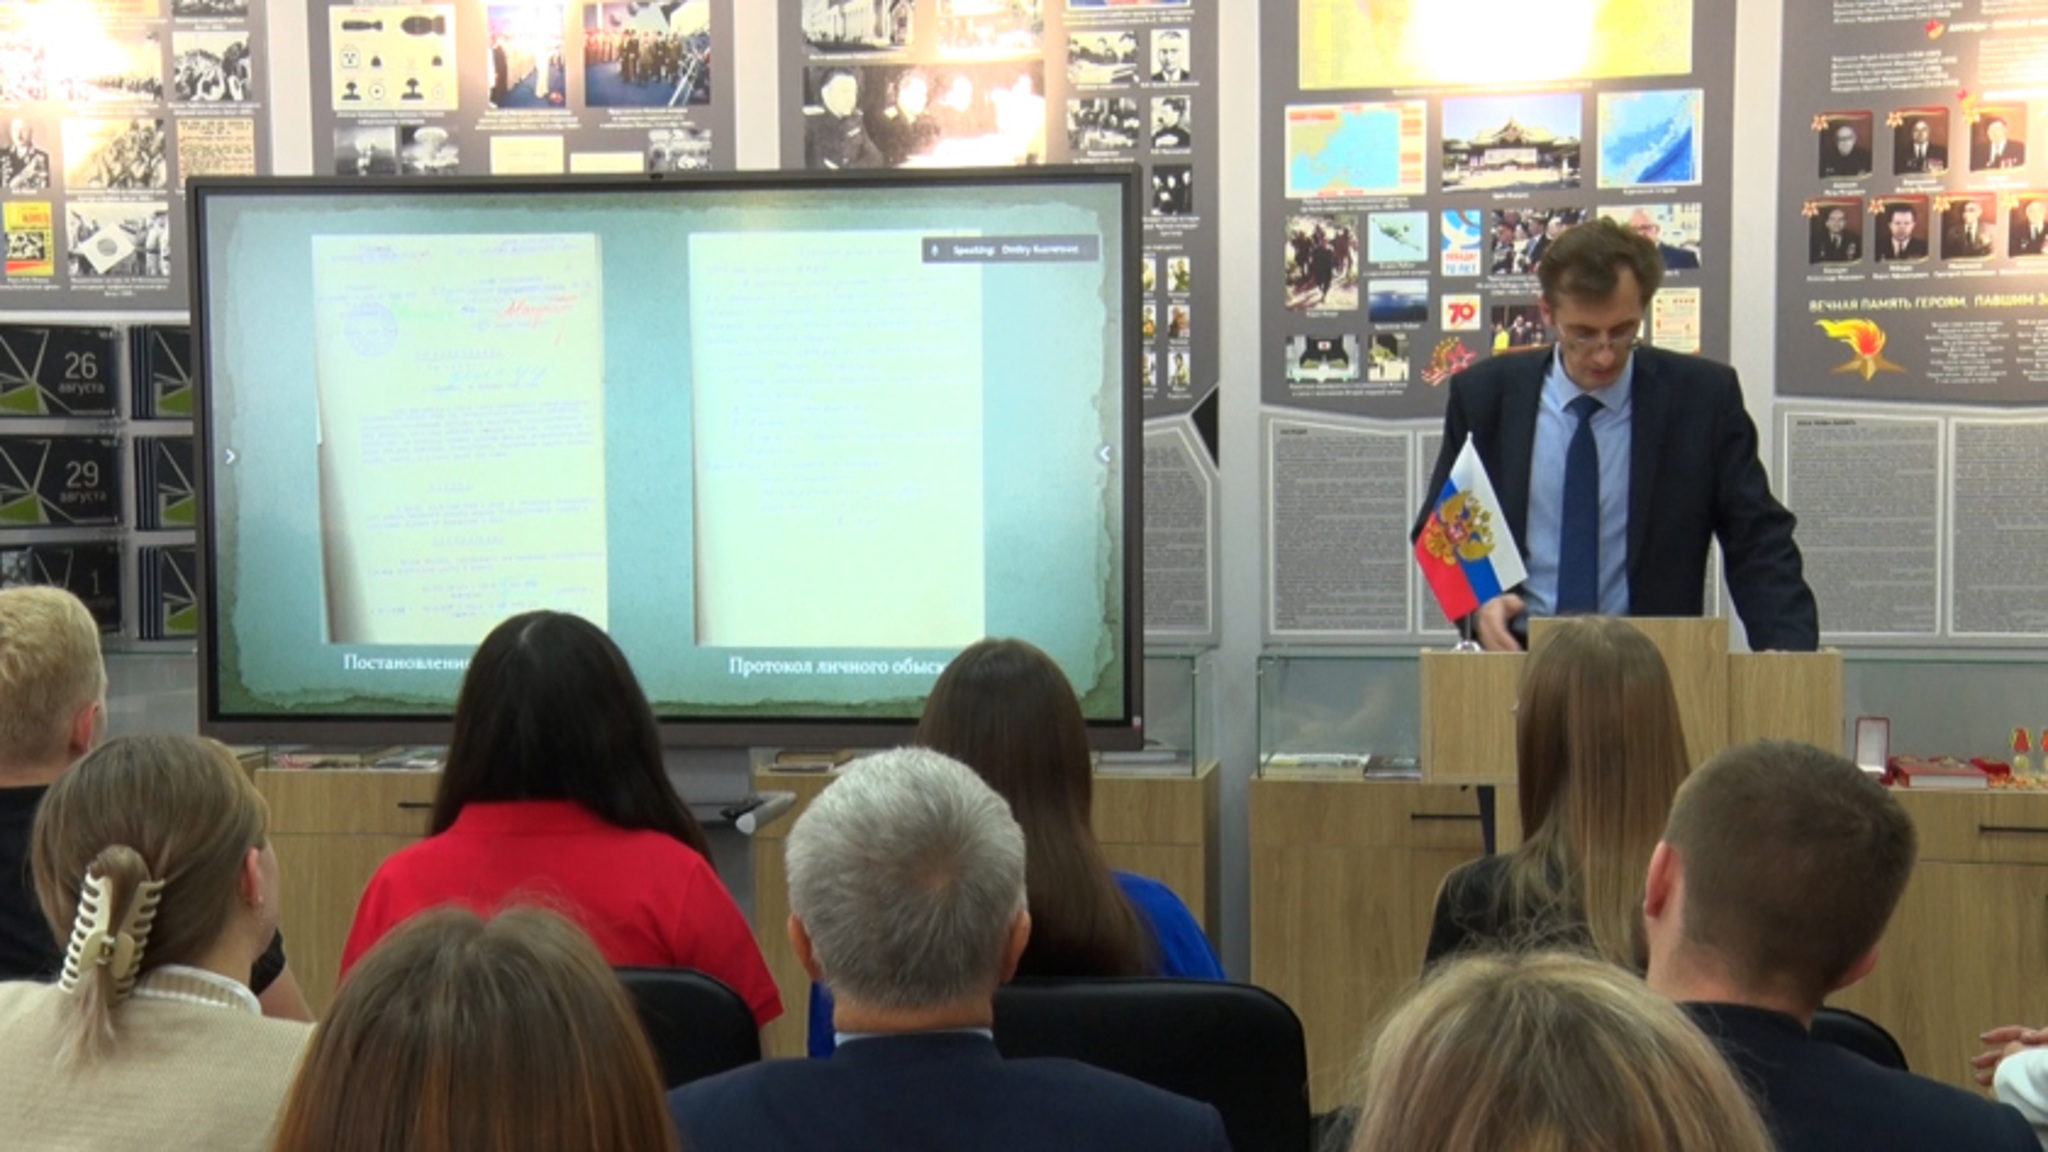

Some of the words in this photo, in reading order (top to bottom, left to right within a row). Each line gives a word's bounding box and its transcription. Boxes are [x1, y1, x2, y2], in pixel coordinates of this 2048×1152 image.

[1448, 302, 1475, 324] 70
[1809, 298, 1859, 313] ВЕЧНАЯ
[1861, 297, 1912, 311] ПАМЯТЬ
[1974, 293, 2034, 307] ПАВШИМ
[65, 351, 97, 379] 26
[59, 382, 105, 395] августа
[66, 460, 99, 488] 29
[60, 491, 107, 503] августа
[729, 656, 813, 679] Протокол
[816, 660, 888, 674] личного
